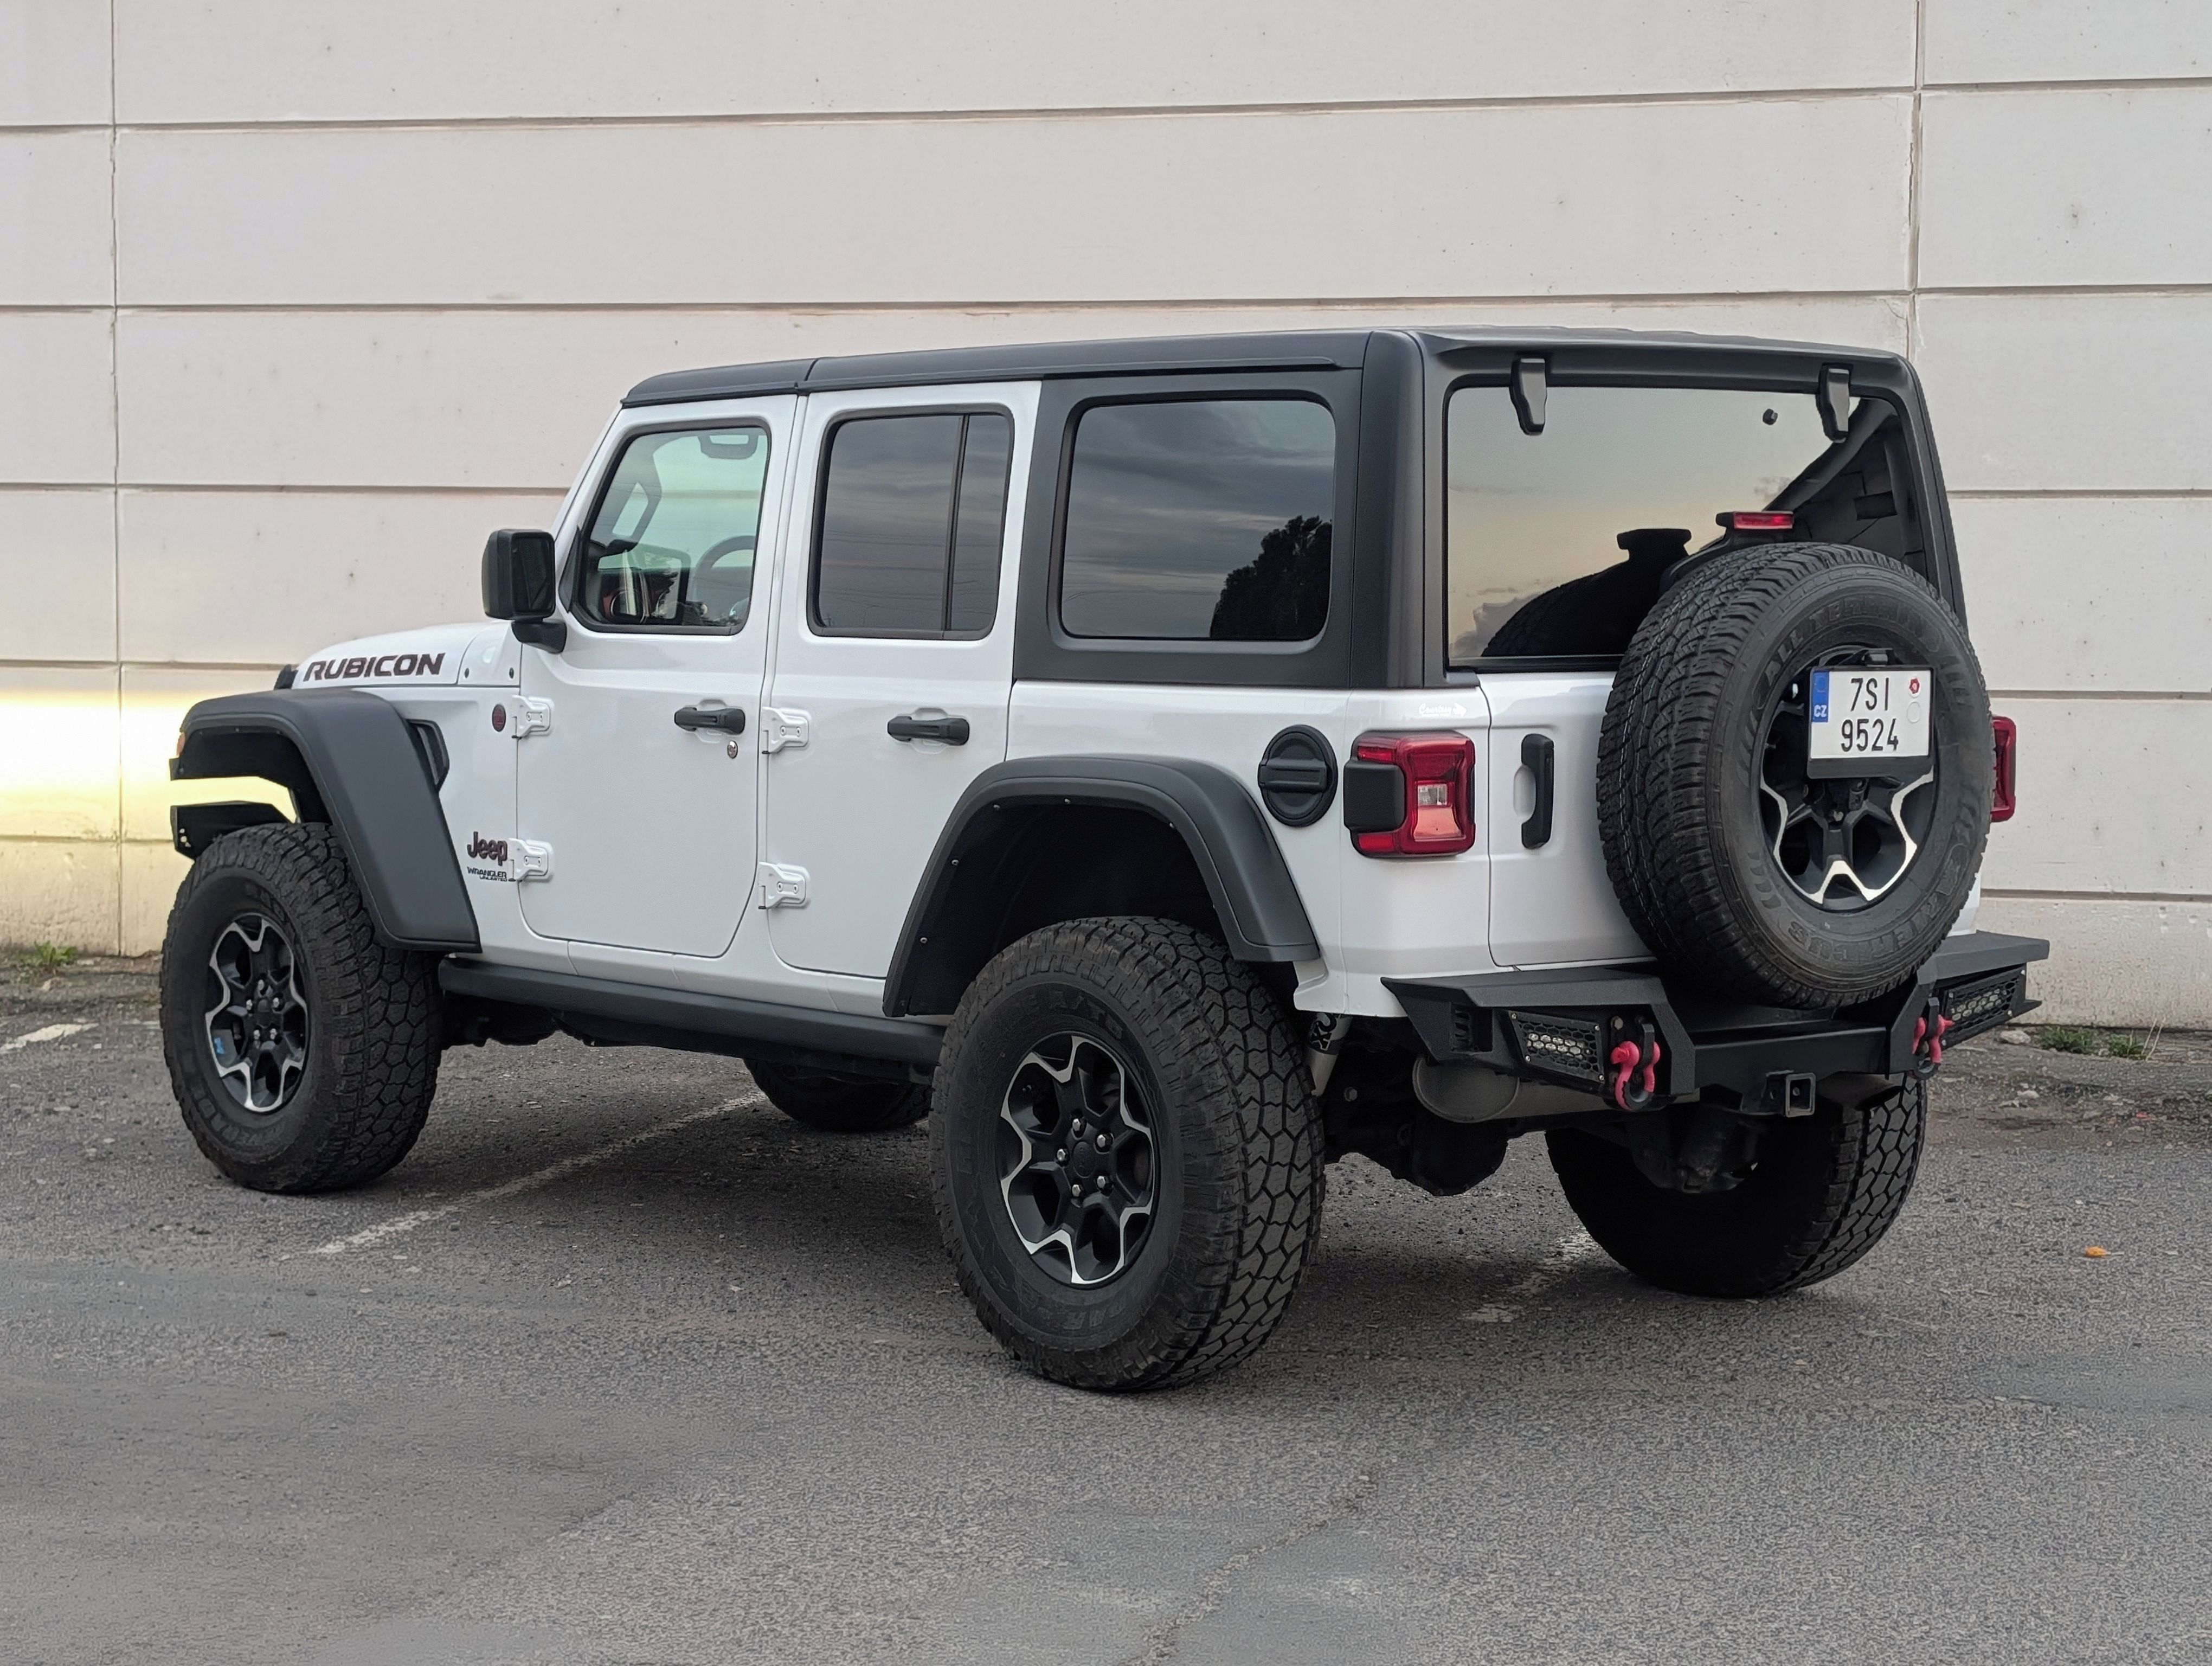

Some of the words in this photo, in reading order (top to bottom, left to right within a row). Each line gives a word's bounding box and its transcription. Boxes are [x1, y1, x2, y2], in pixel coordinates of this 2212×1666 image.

[303, 652, 446, 682] RUBICON
[1850, 677, 1889, 711] 7SI
[1814, 705, 1828, 717] CZ
[1841, 718, 1899, 752] 9524
[467, 831, 507, 866] Jeep
[467, 866, 507, 878] WRANGLER
